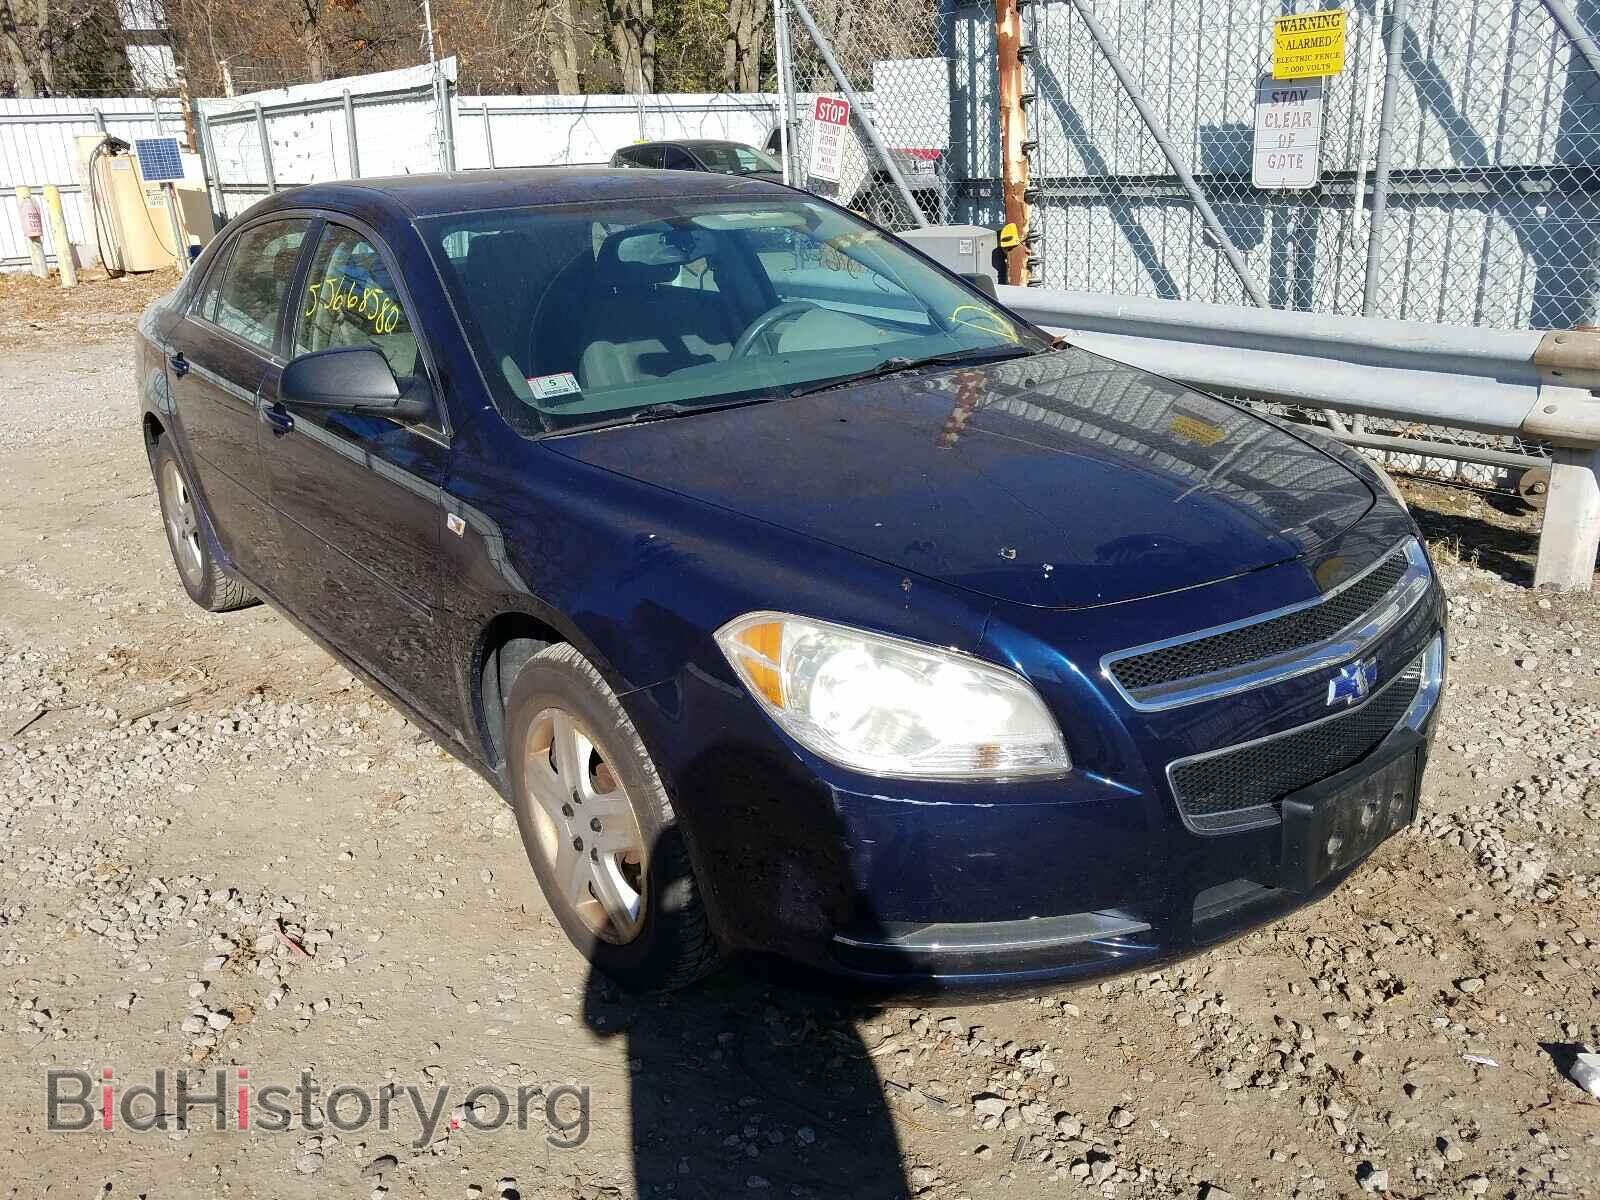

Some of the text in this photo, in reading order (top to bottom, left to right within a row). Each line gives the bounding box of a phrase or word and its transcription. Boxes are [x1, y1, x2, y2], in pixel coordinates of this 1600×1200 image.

[1280, 14, 1340, 33] WARNING
[1285, 36, 1331, 51] ALARMED
[1276, 52, 1340, 64] ELECTRIC FENCE
[1307, 63, 1331, 72] VOLTS
[1271, 90, 1308, 107] STAY
[818, 102, 845, 123] STOP
[1264, 111, 1312, 128] CLEAR
[819, 123, 841, 136] SOUND
[819, 136, 838, 148] HORN
[1278, 133, 1296, 148] OF
[1267, 153, 1304, 169] GATE
